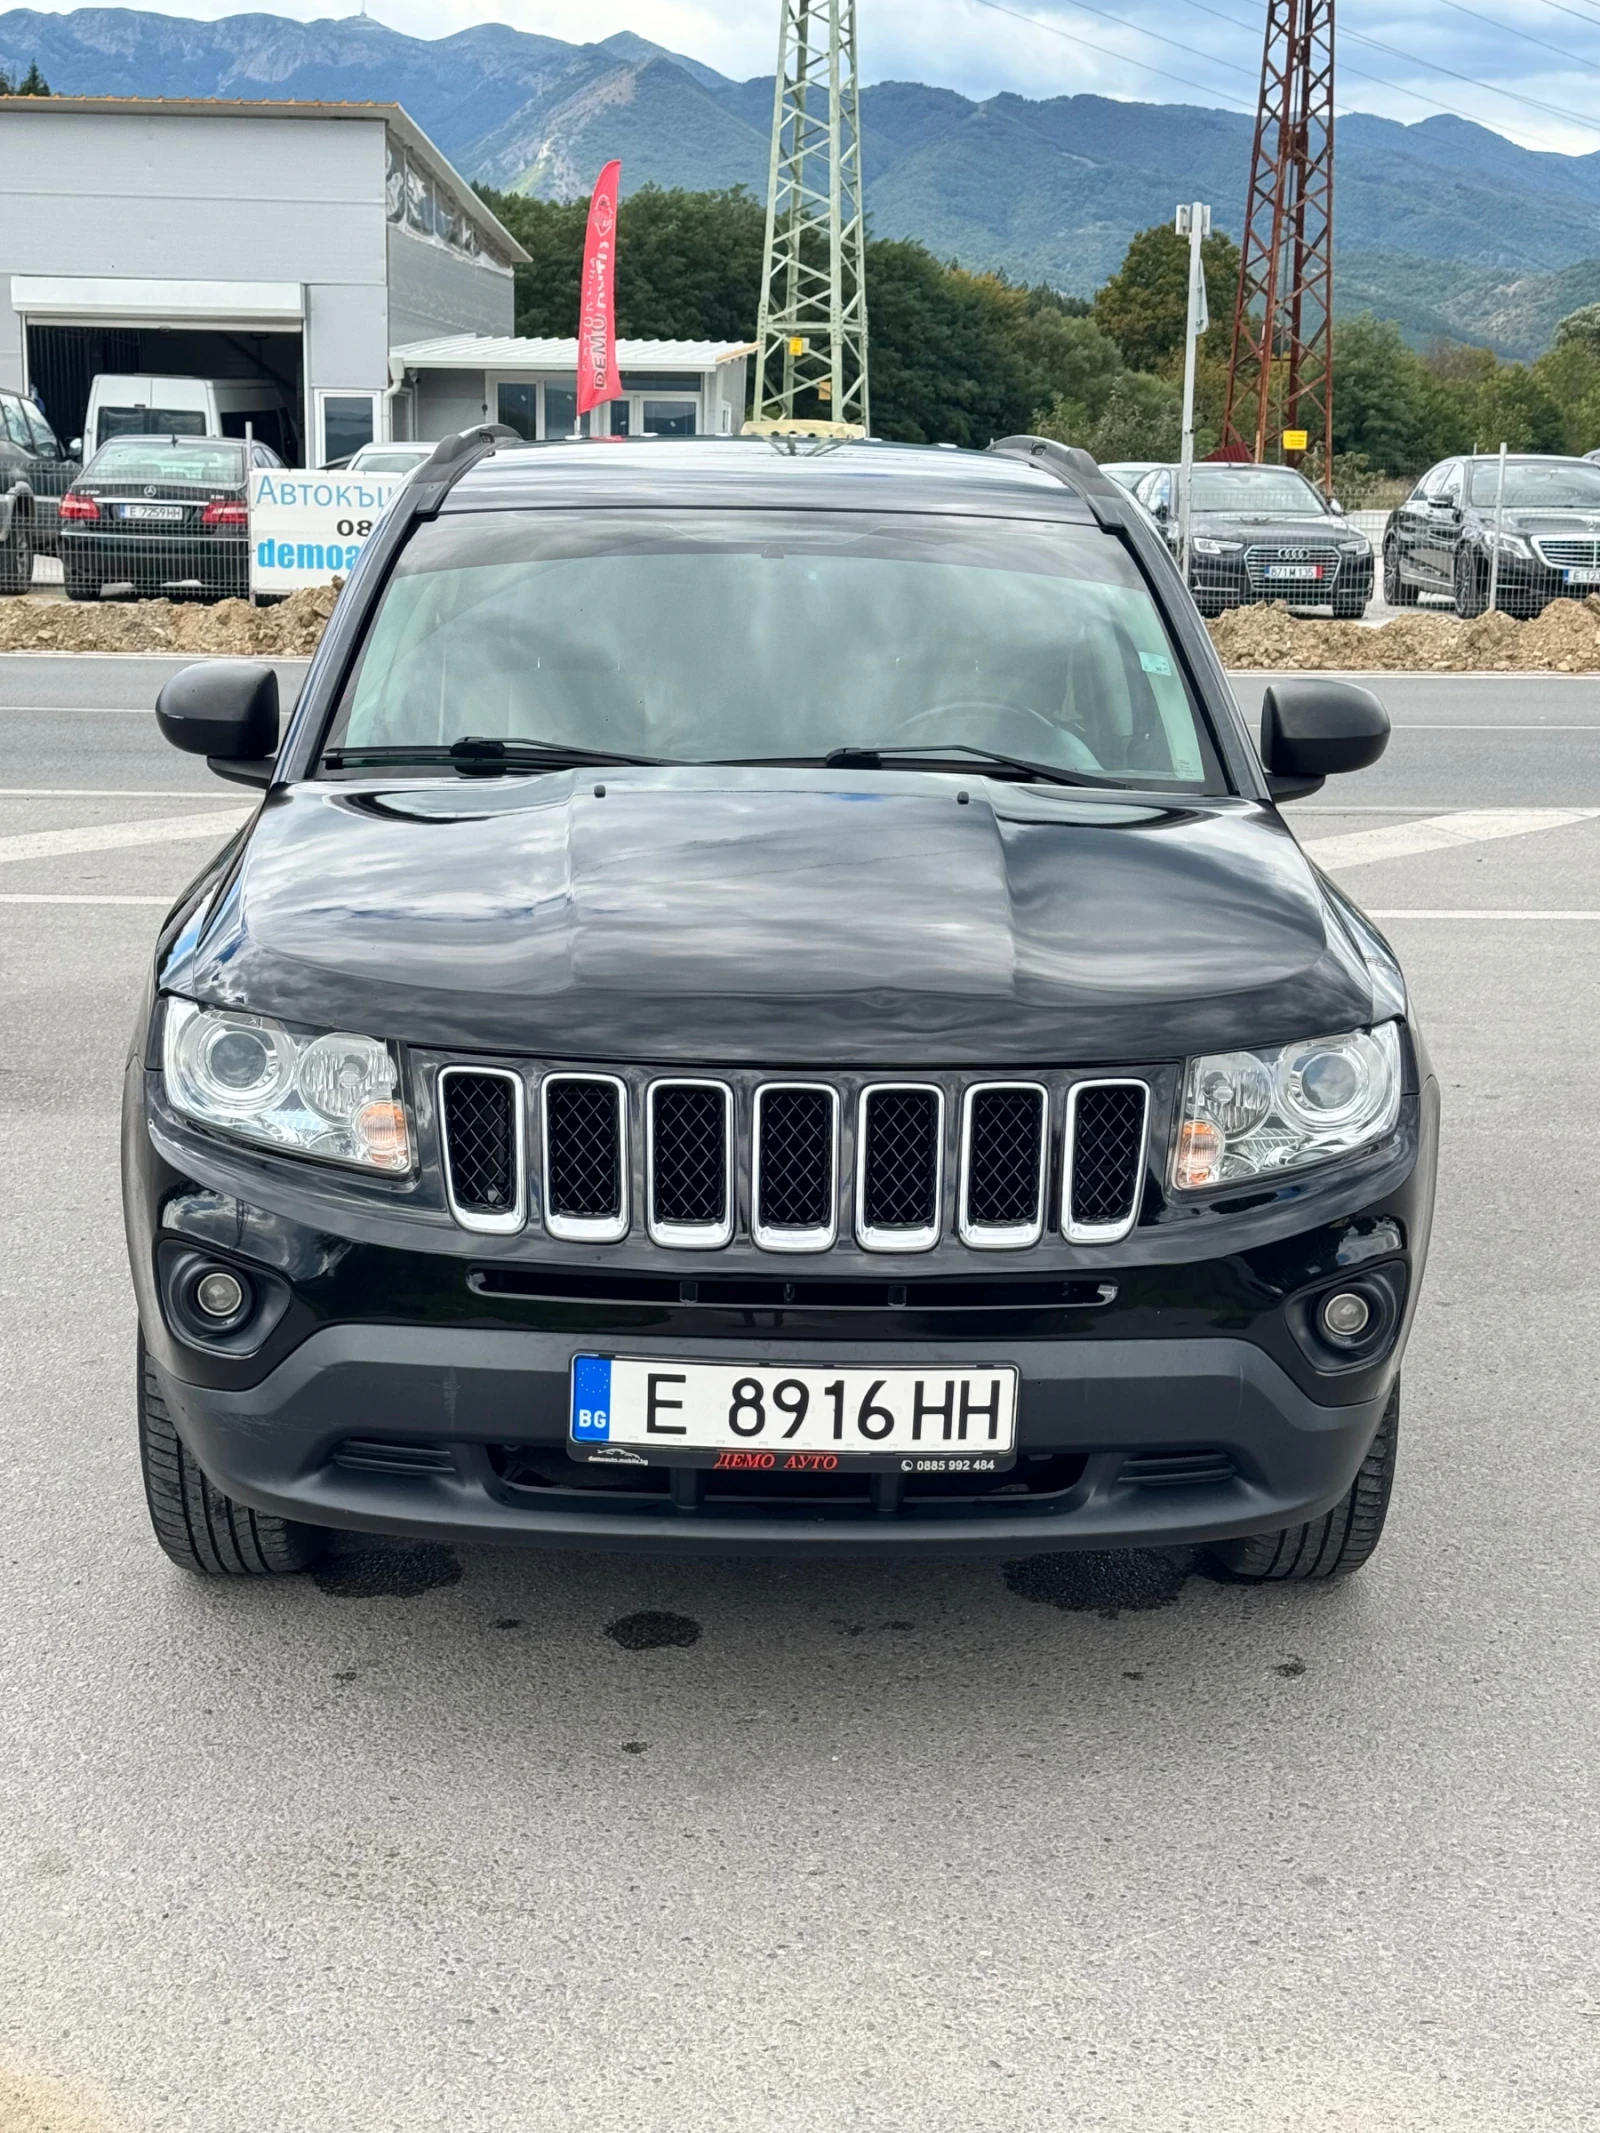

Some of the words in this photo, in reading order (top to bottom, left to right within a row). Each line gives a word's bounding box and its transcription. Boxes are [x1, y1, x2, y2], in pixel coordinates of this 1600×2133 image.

[646, 1373, 687, 1435] E
[578, 1409, 607, 1429] BG
[714, 1453, 775, 1469] ДЕМО
[784, 1455, 838, 1469] АУТО
[916, 1460, 945, 1471] 0885
[949, 1460, 970, 1471] 992
[972, 1460, 995, 1471] 484
